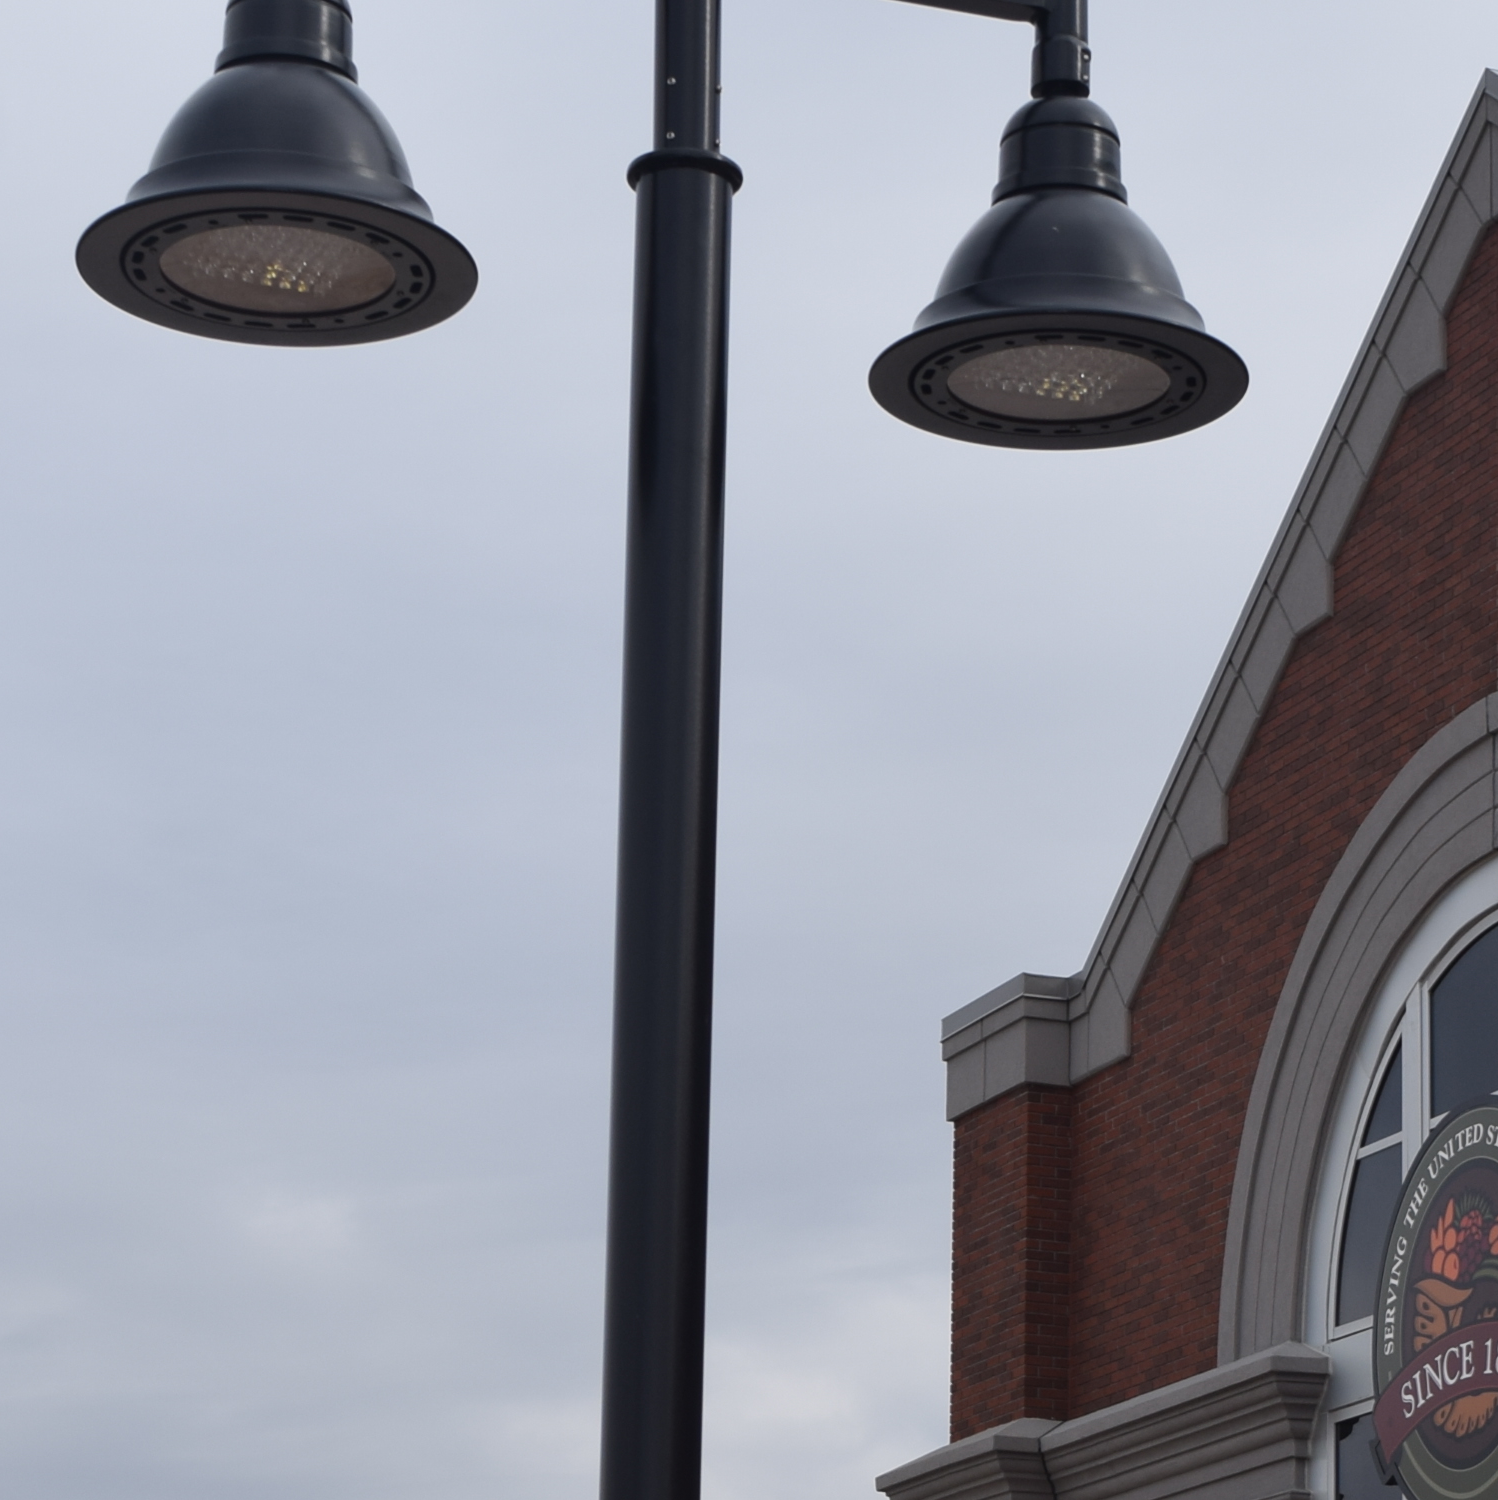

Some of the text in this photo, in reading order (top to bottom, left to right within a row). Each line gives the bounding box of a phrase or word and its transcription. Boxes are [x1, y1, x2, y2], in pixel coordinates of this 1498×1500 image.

[1384, 1236, 1408, 1356] SERVING
[1403, 1178, 1429, 1228] THE
[1427, 1123, 1484, 1181] UNITED
[1400, 1339, 1475, 1419] SINCE
